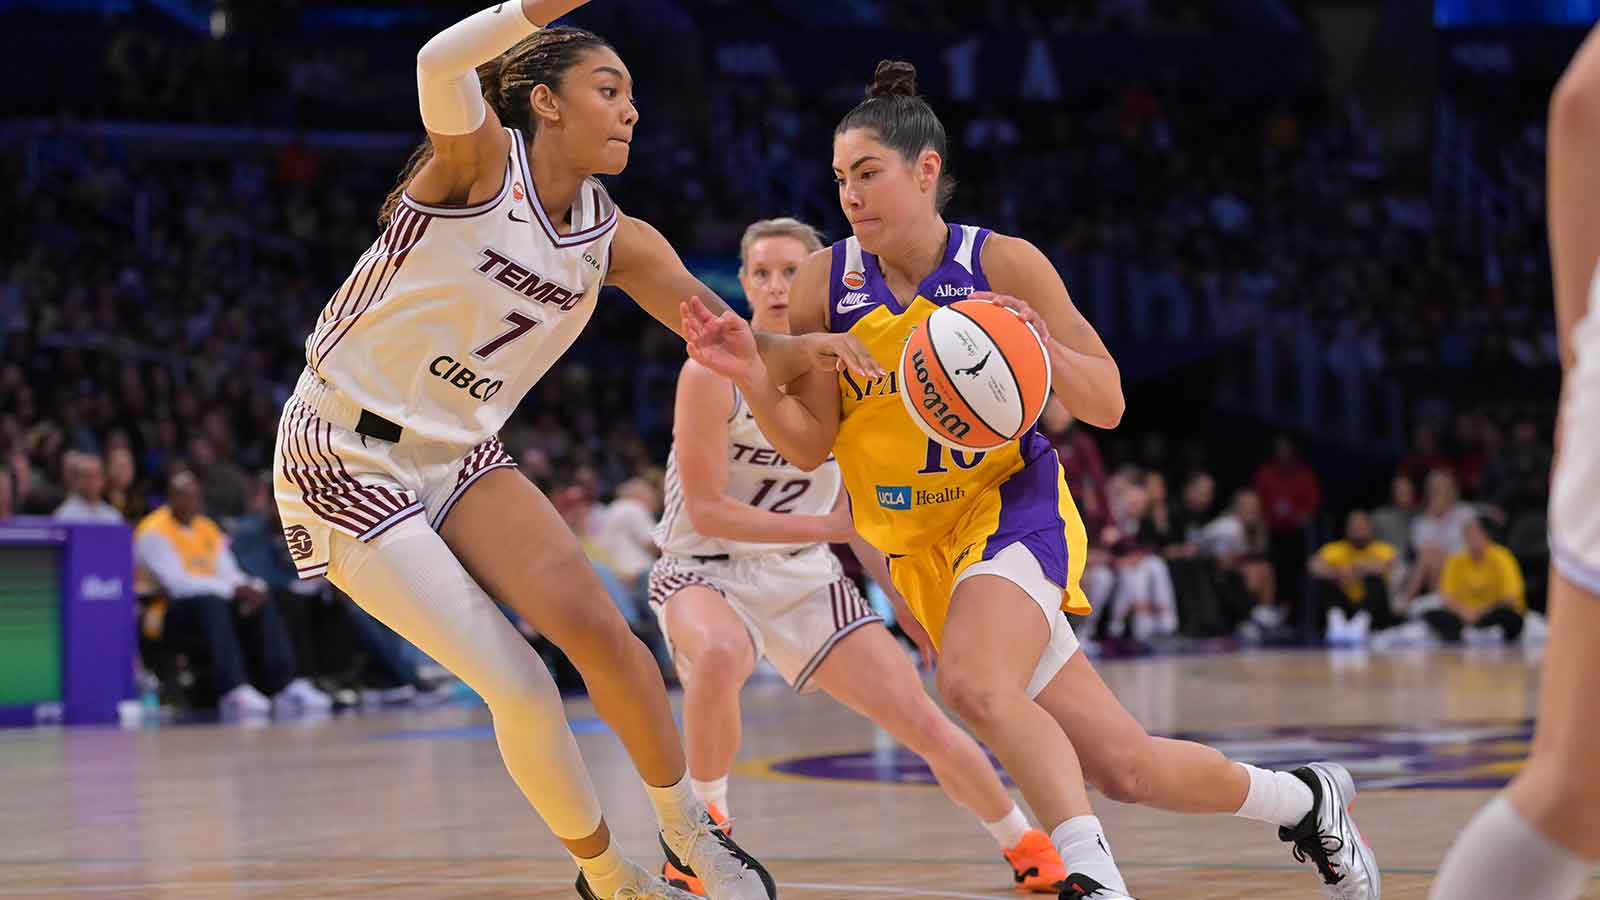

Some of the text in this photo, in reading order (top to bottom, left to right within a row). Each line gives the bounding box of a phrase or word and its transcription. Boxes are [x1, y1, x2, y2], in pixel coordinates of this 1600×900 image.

[478, 248, 585, 312] TEMPO
[934, 284, 976, 297] Albert
[842, 291, 870, 305] NIKE
[474, 311, 537, 359] 7
[842, 367, 901, 401] SPA
[912, 350, 971, 440] Wilson
[750, 479, 812, 514] 12
[878, 486, 966, 506] UCLA Health
